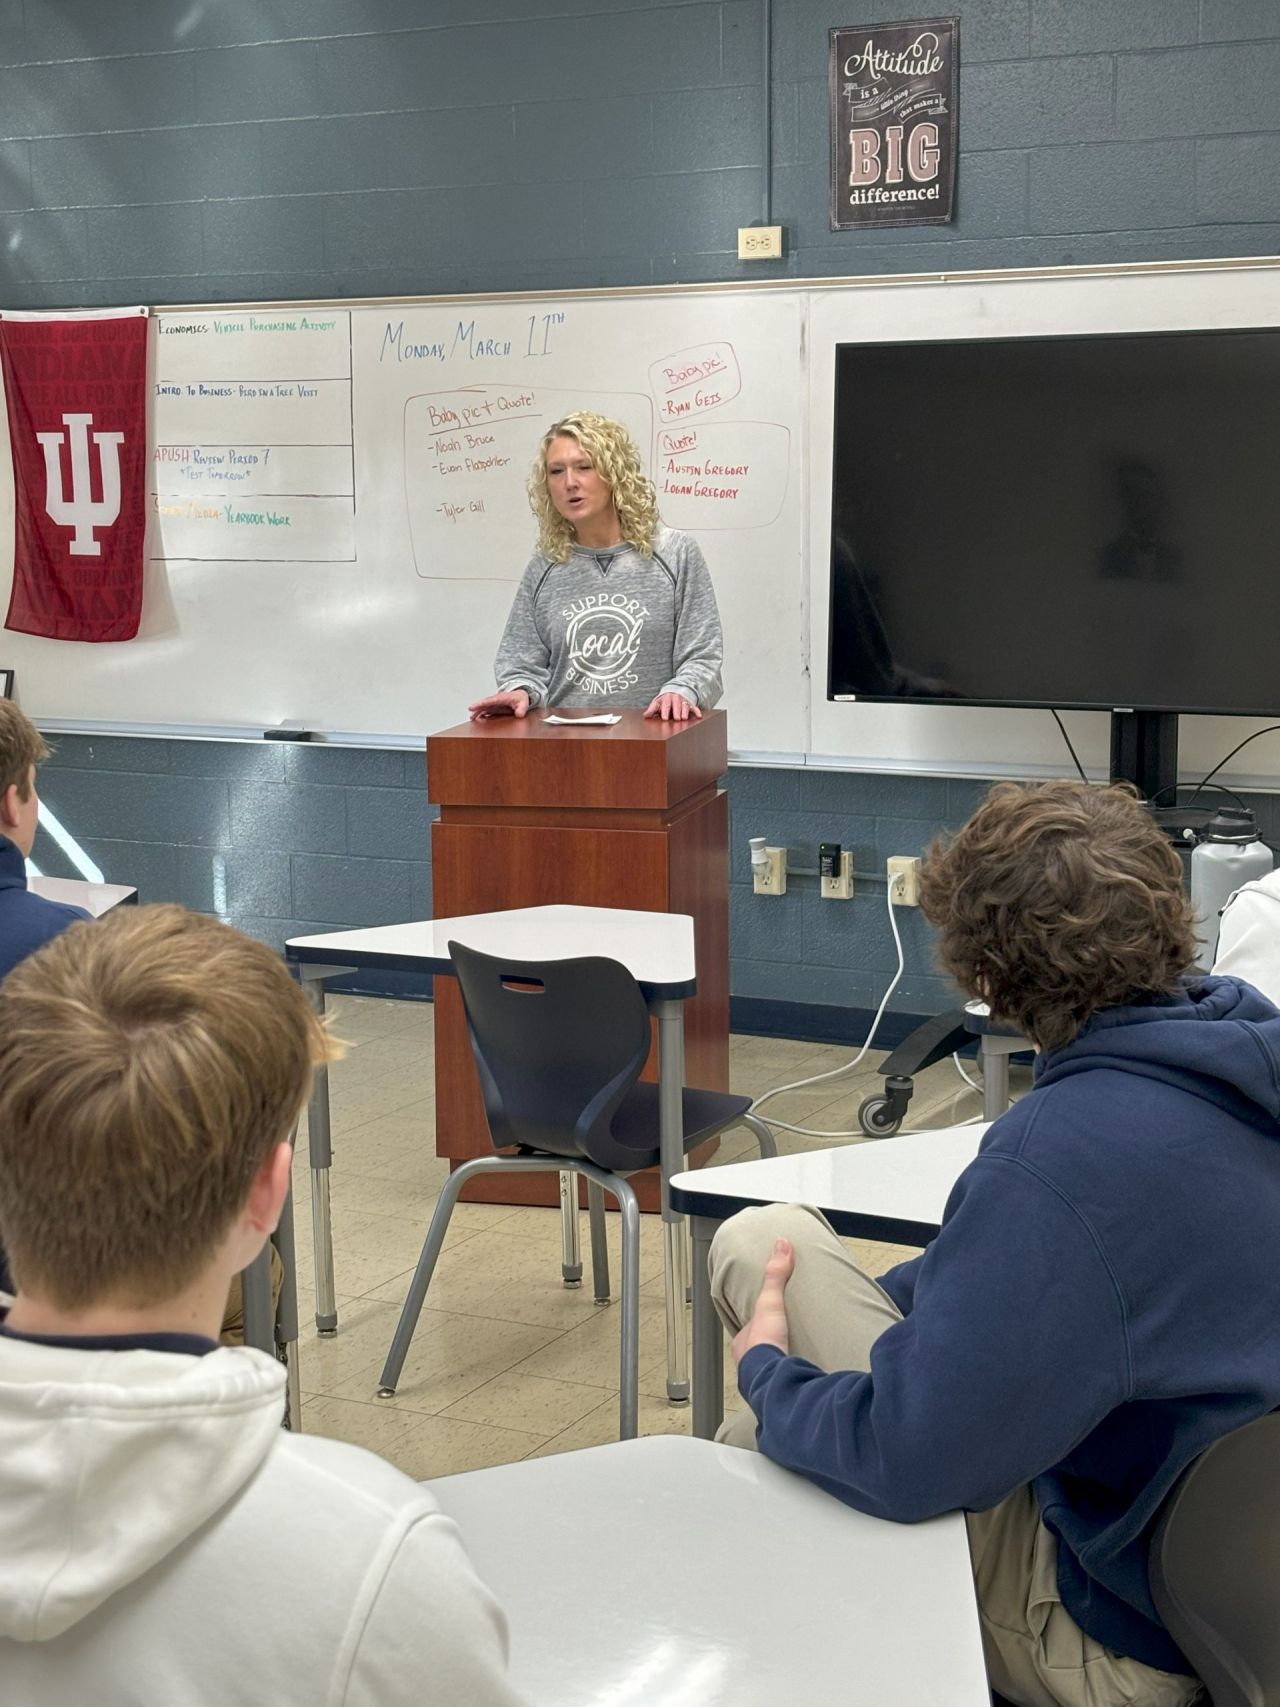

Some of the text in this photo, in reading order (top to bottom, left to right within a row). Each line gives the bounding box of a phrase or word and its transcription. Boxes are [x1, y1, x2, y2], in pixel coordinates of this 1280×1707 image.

[844, 32, 945, 80] Attitude
[860, 87, 879, 99] is a
[899, 106, 913, 118] that
[913, 99, 934, 110] makes
[849, 122, 941, 186] BIG
[849, 184, 941, 205] difference!
[450, 320, 512, 360] MARCH
[427, 405, 461, 429] Baby
[462, 406, 482, 426] pic
[497, 392, 536, 411] Quote!
[464, 434, 495, 449] Bruce
[153, 448, 189, 463] APUSH
[262, 448, 270, 466] 7
[704, 459, 750, 476] GREGORY
[694, 481, 740, 499] GREGORY
[469, 500, 486, 513] Gill
[562, 593, 650, 620] SUPPORT
[568, 618, 644, 659] Local
[565, 666, 639, 695] BUSINESS
